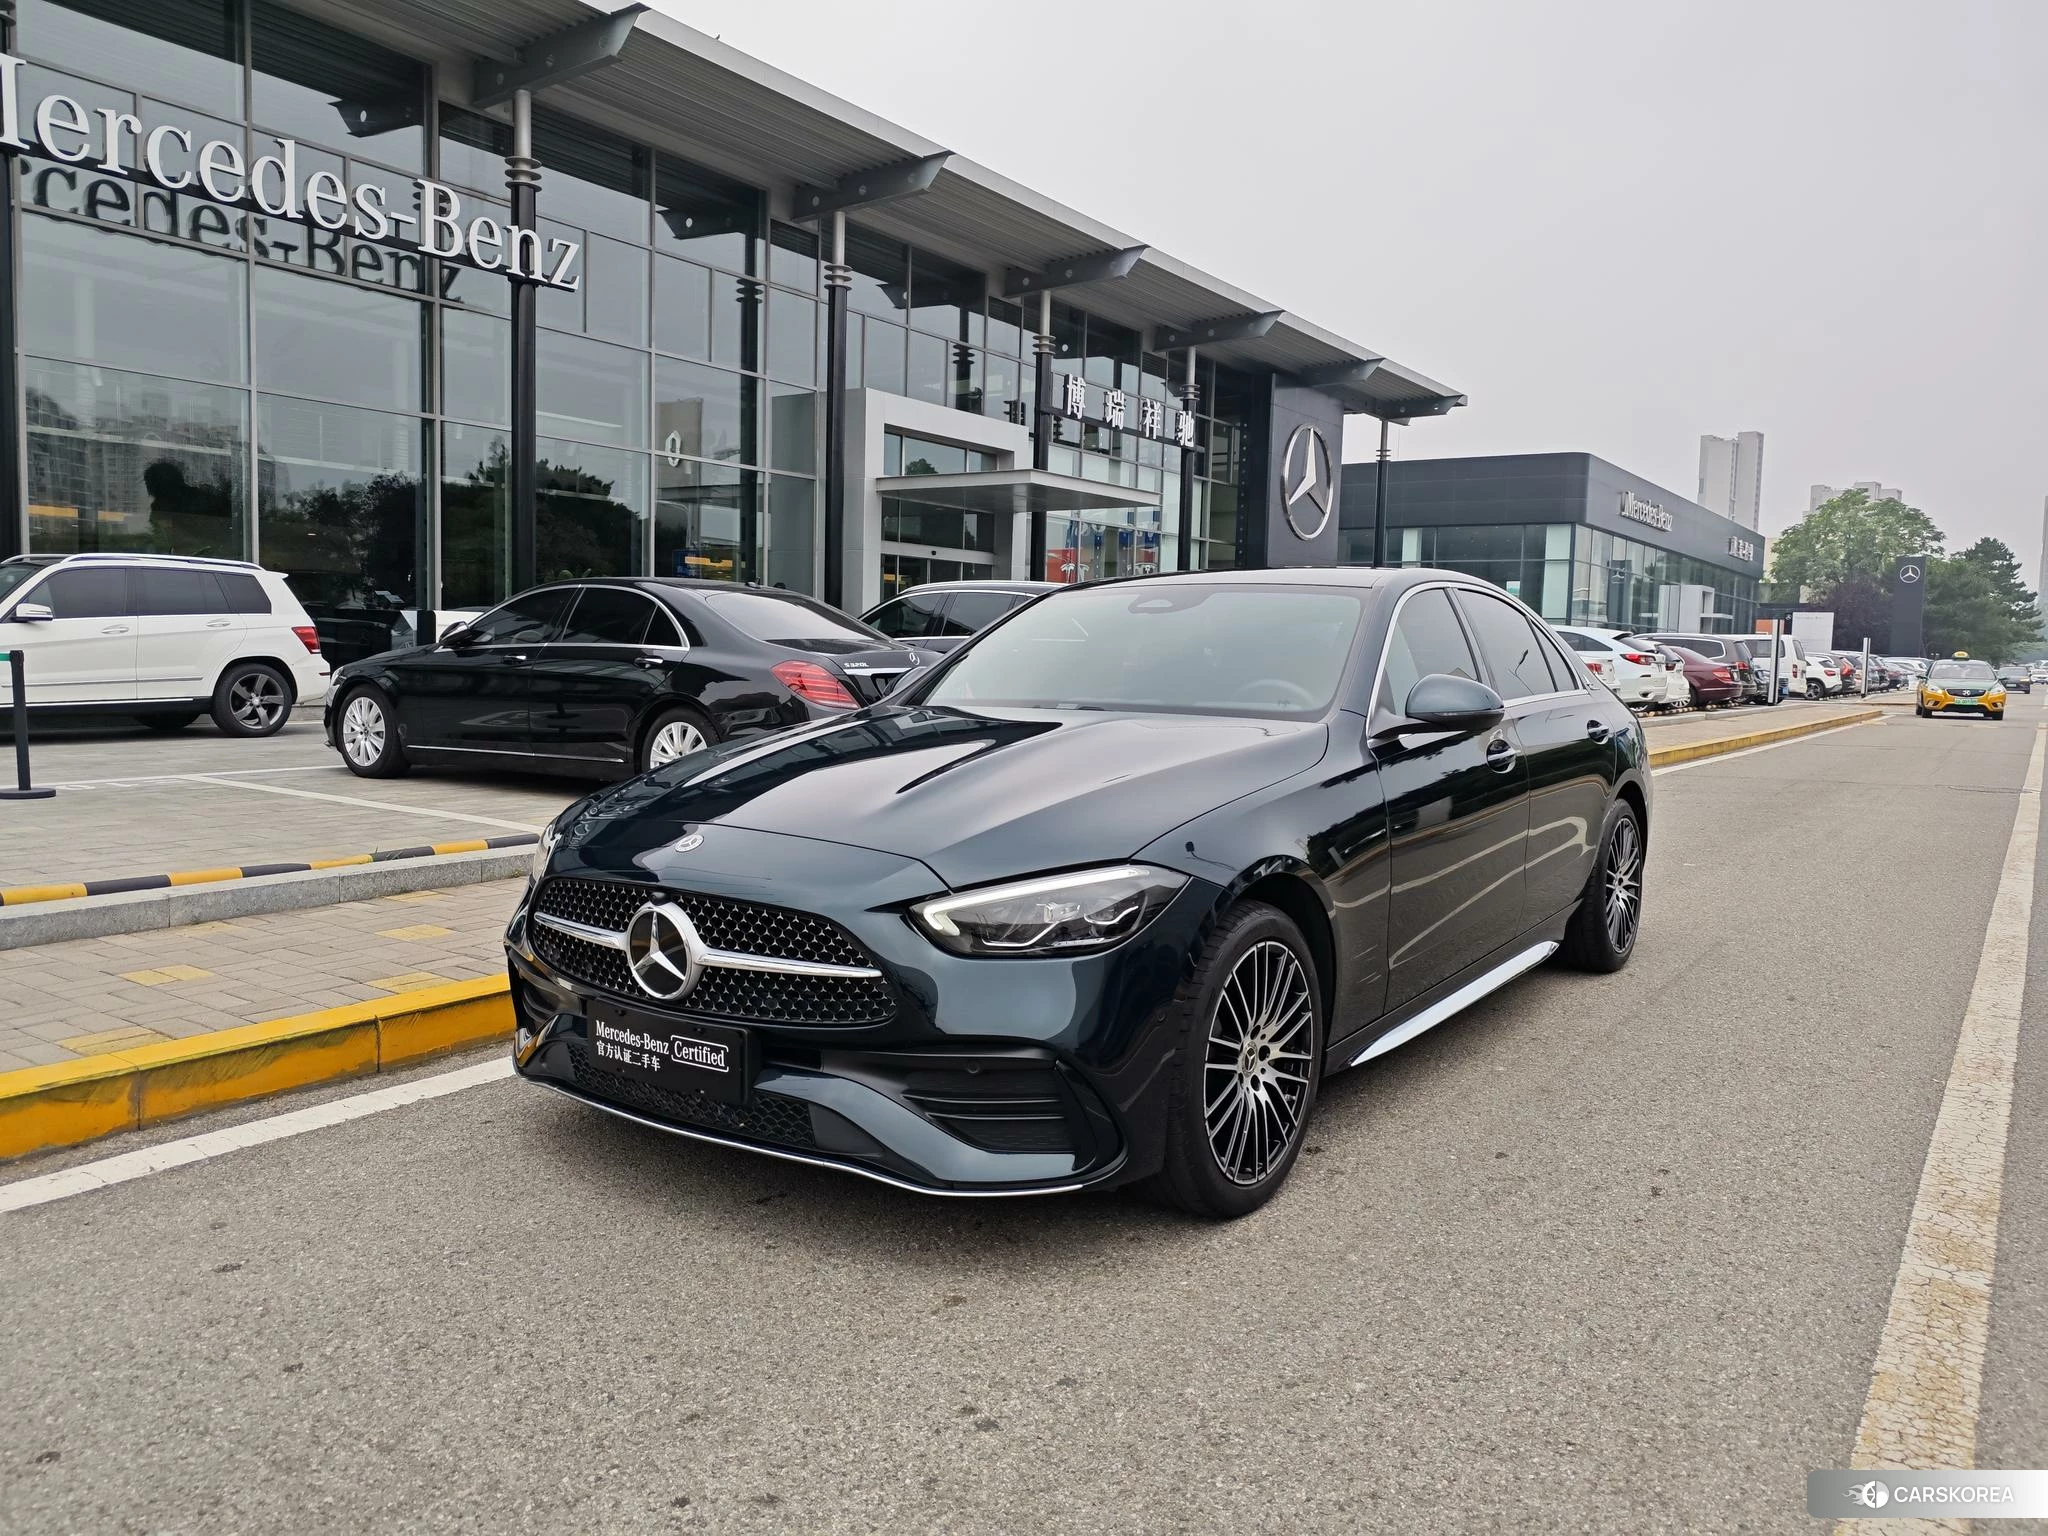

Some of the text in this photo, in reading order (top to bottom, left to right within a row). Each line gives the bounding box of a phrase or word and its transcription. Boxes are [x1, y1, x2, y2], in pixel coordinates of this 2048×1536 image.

[1066, 373, 1195, 448] 博瑞祥驰
[595, 1019, 726, 1067] Mercedes-Benz Certified
[596, 1040, 661, 1072] 官方认证二手车
